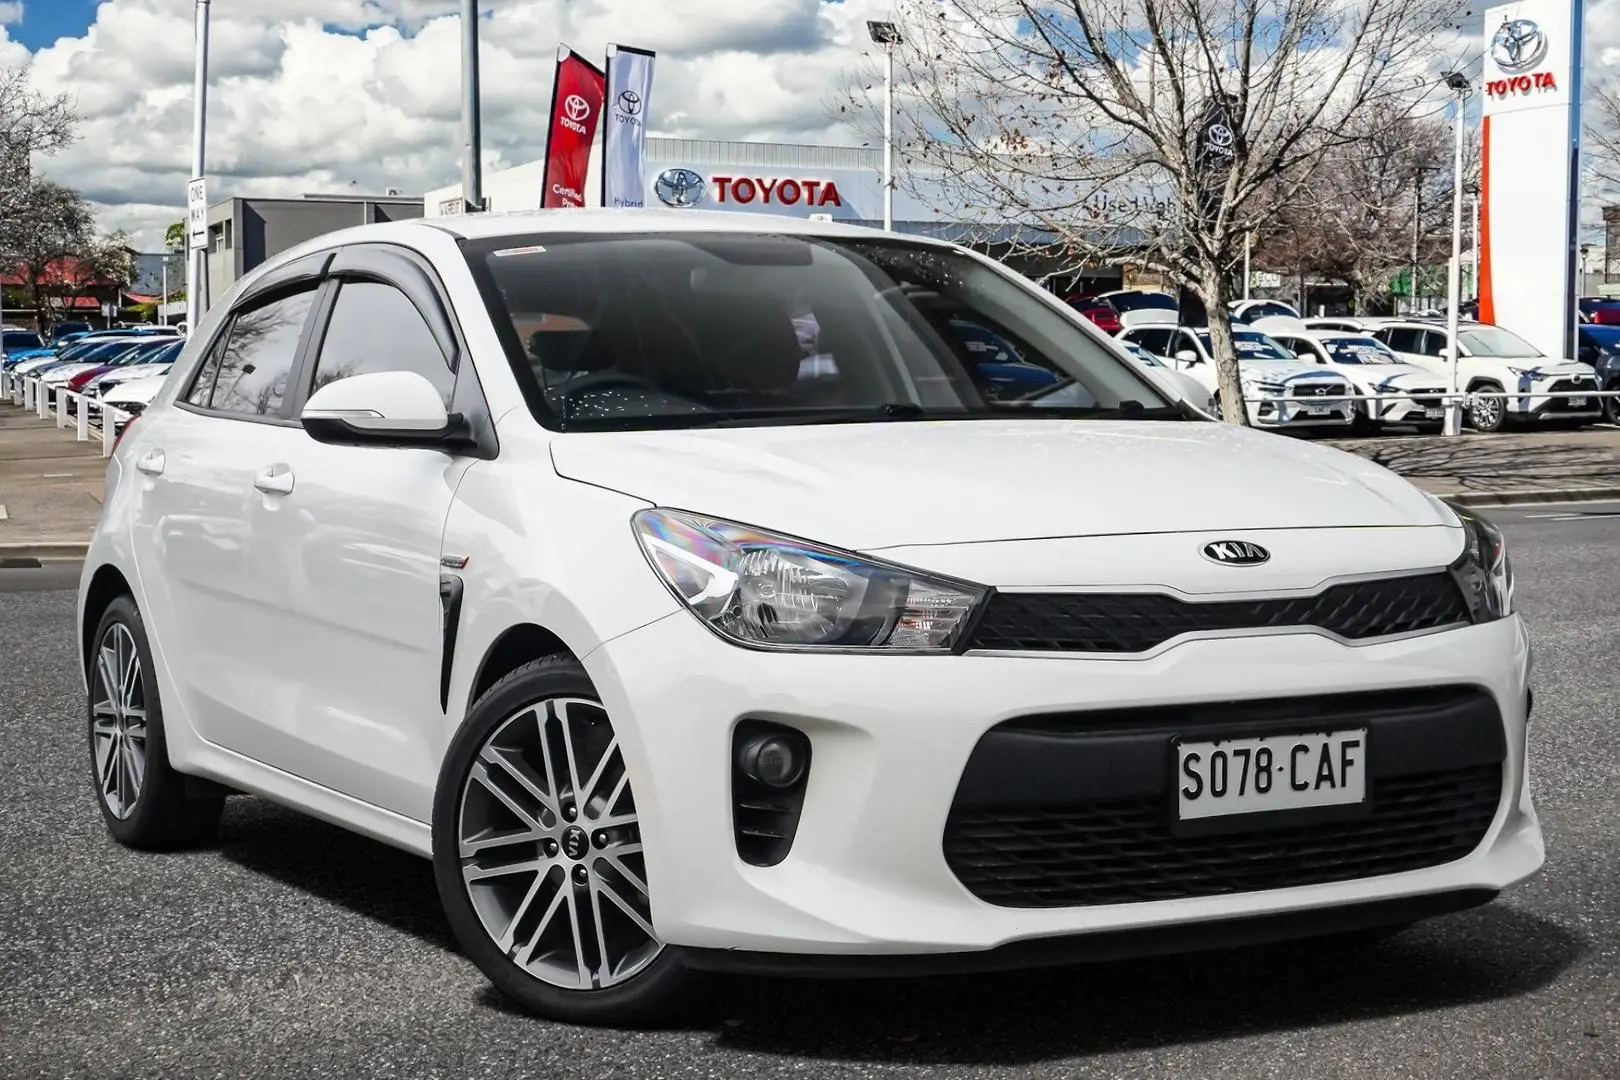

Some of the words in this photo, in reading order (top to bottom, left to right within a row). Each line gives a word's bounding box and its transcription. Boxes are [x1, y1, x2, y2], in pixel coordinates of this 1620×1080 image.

[1486, 72, 1556, 96] TOYOTA
[560, 116, 586, 134] TOYOTA
[615, 114, 642, 127] TOYOTA
[191, 185, 204, 202] ONE
[712, 177, 842, 207] TOYOTA
[614, 196, 643, 208] Hybrid
[191, 207, 205, 223] WAY
[1209, 542, 1265, 560] KIA
